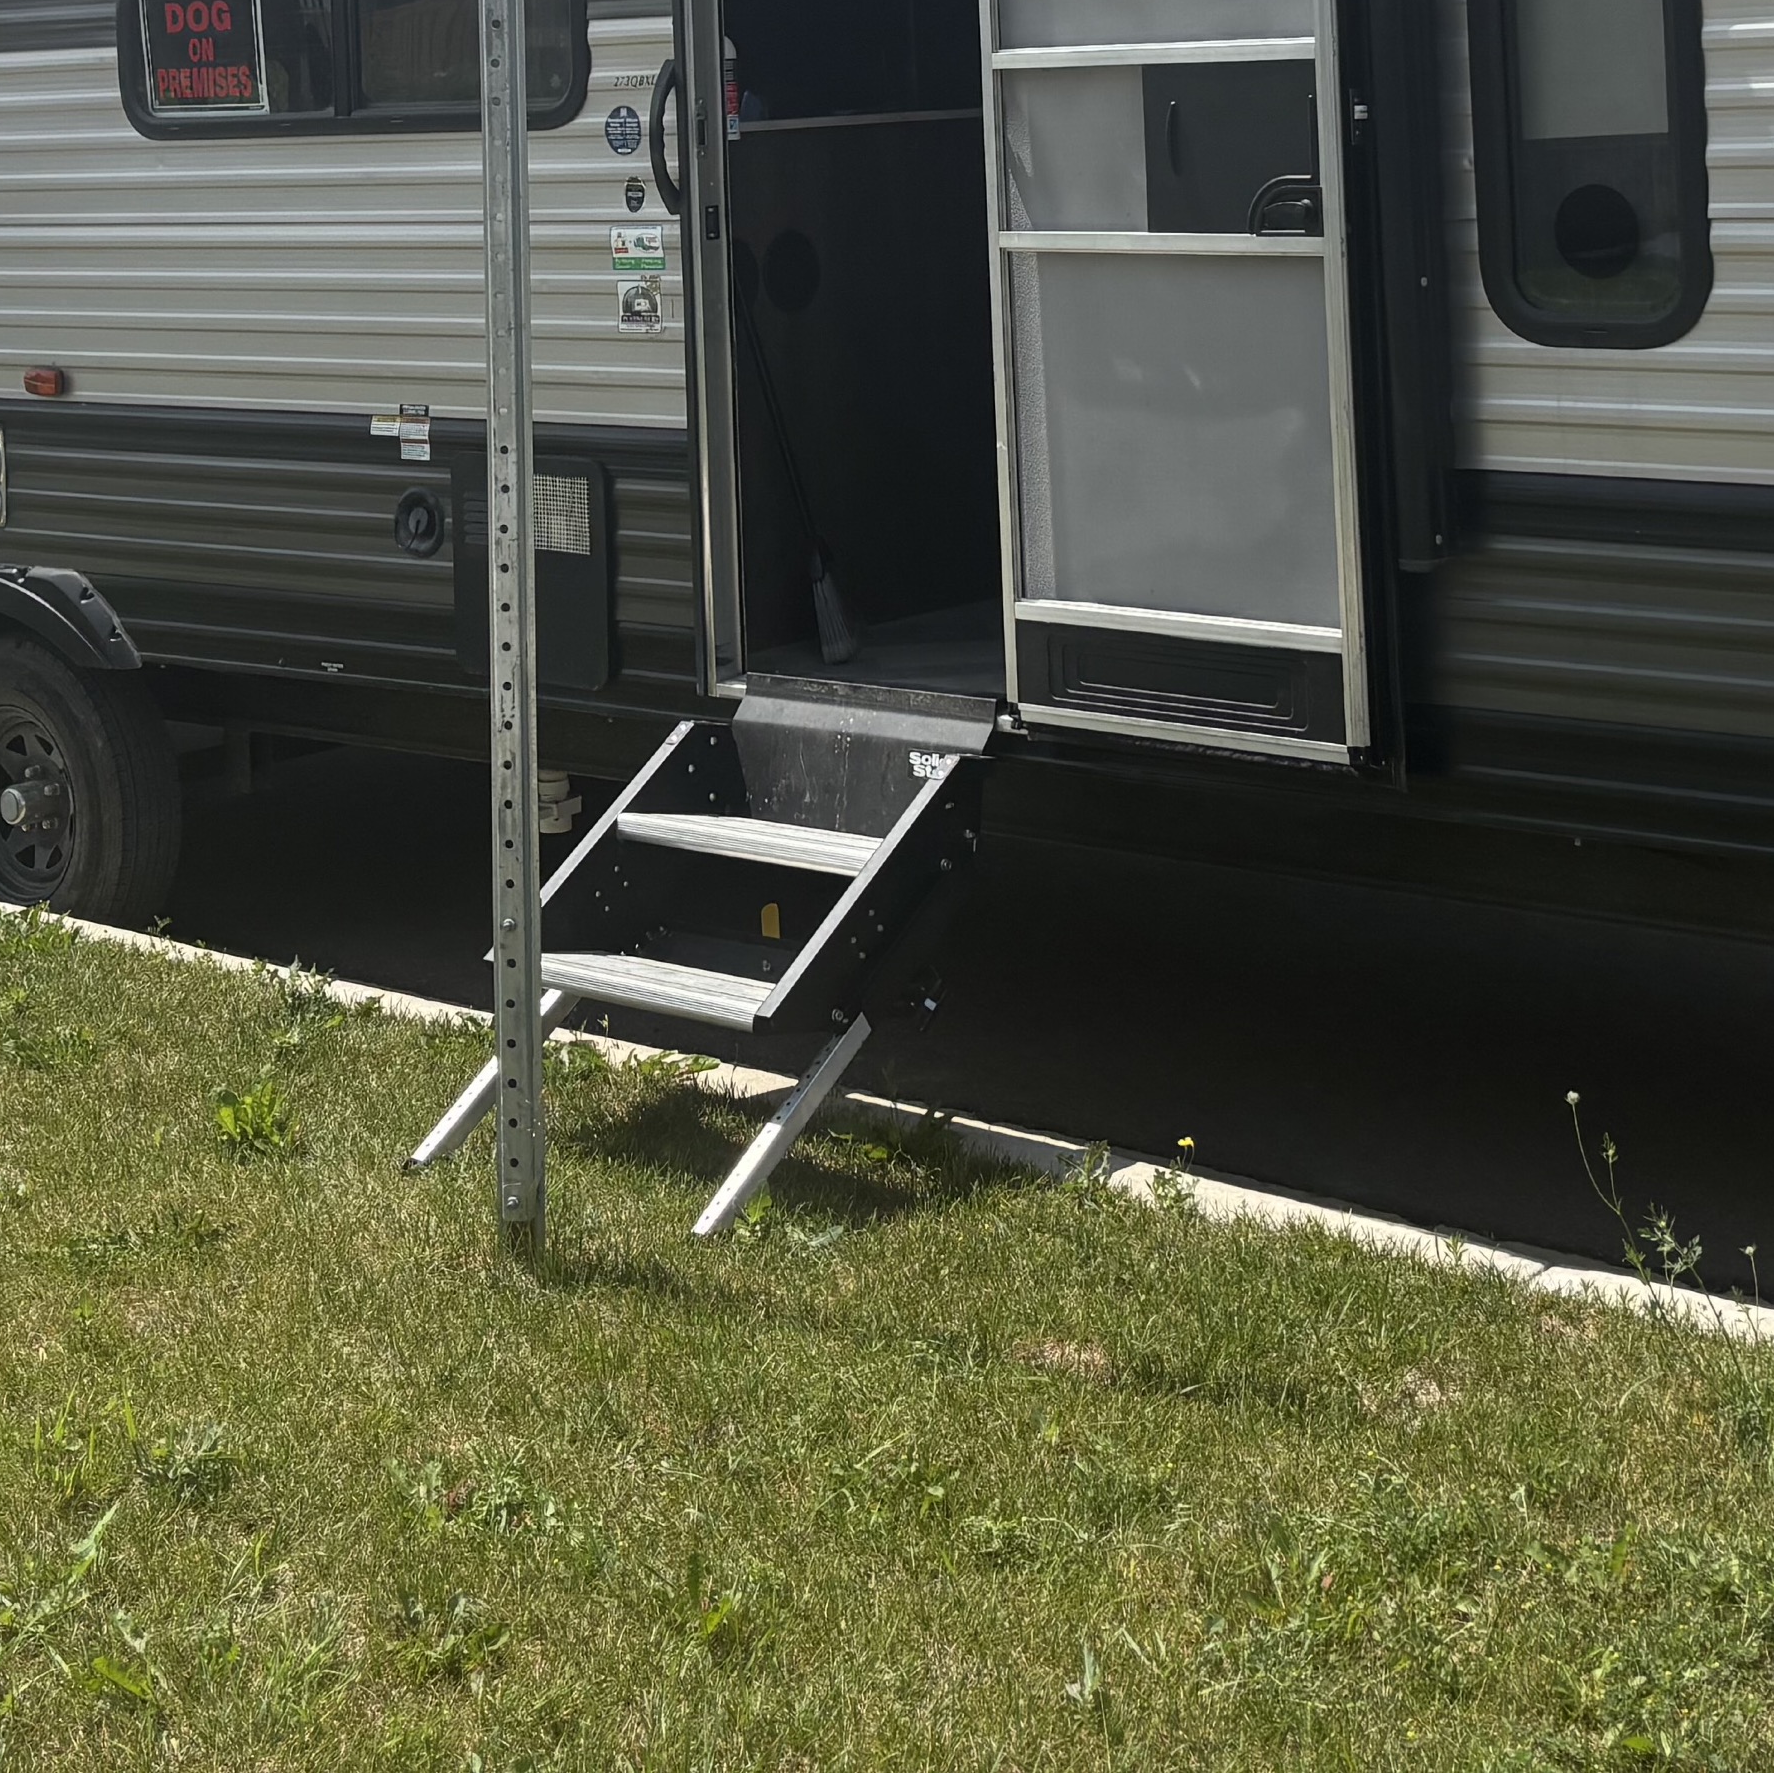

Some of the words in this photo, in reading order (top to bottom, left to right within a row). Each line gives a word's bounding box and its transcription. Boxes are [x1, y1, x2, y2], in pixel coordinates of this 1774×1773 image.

[164, 0, 232, 33] DOG
[188, 37, 215, 63] ON
[157, 65, 253, 99] PREMISES
